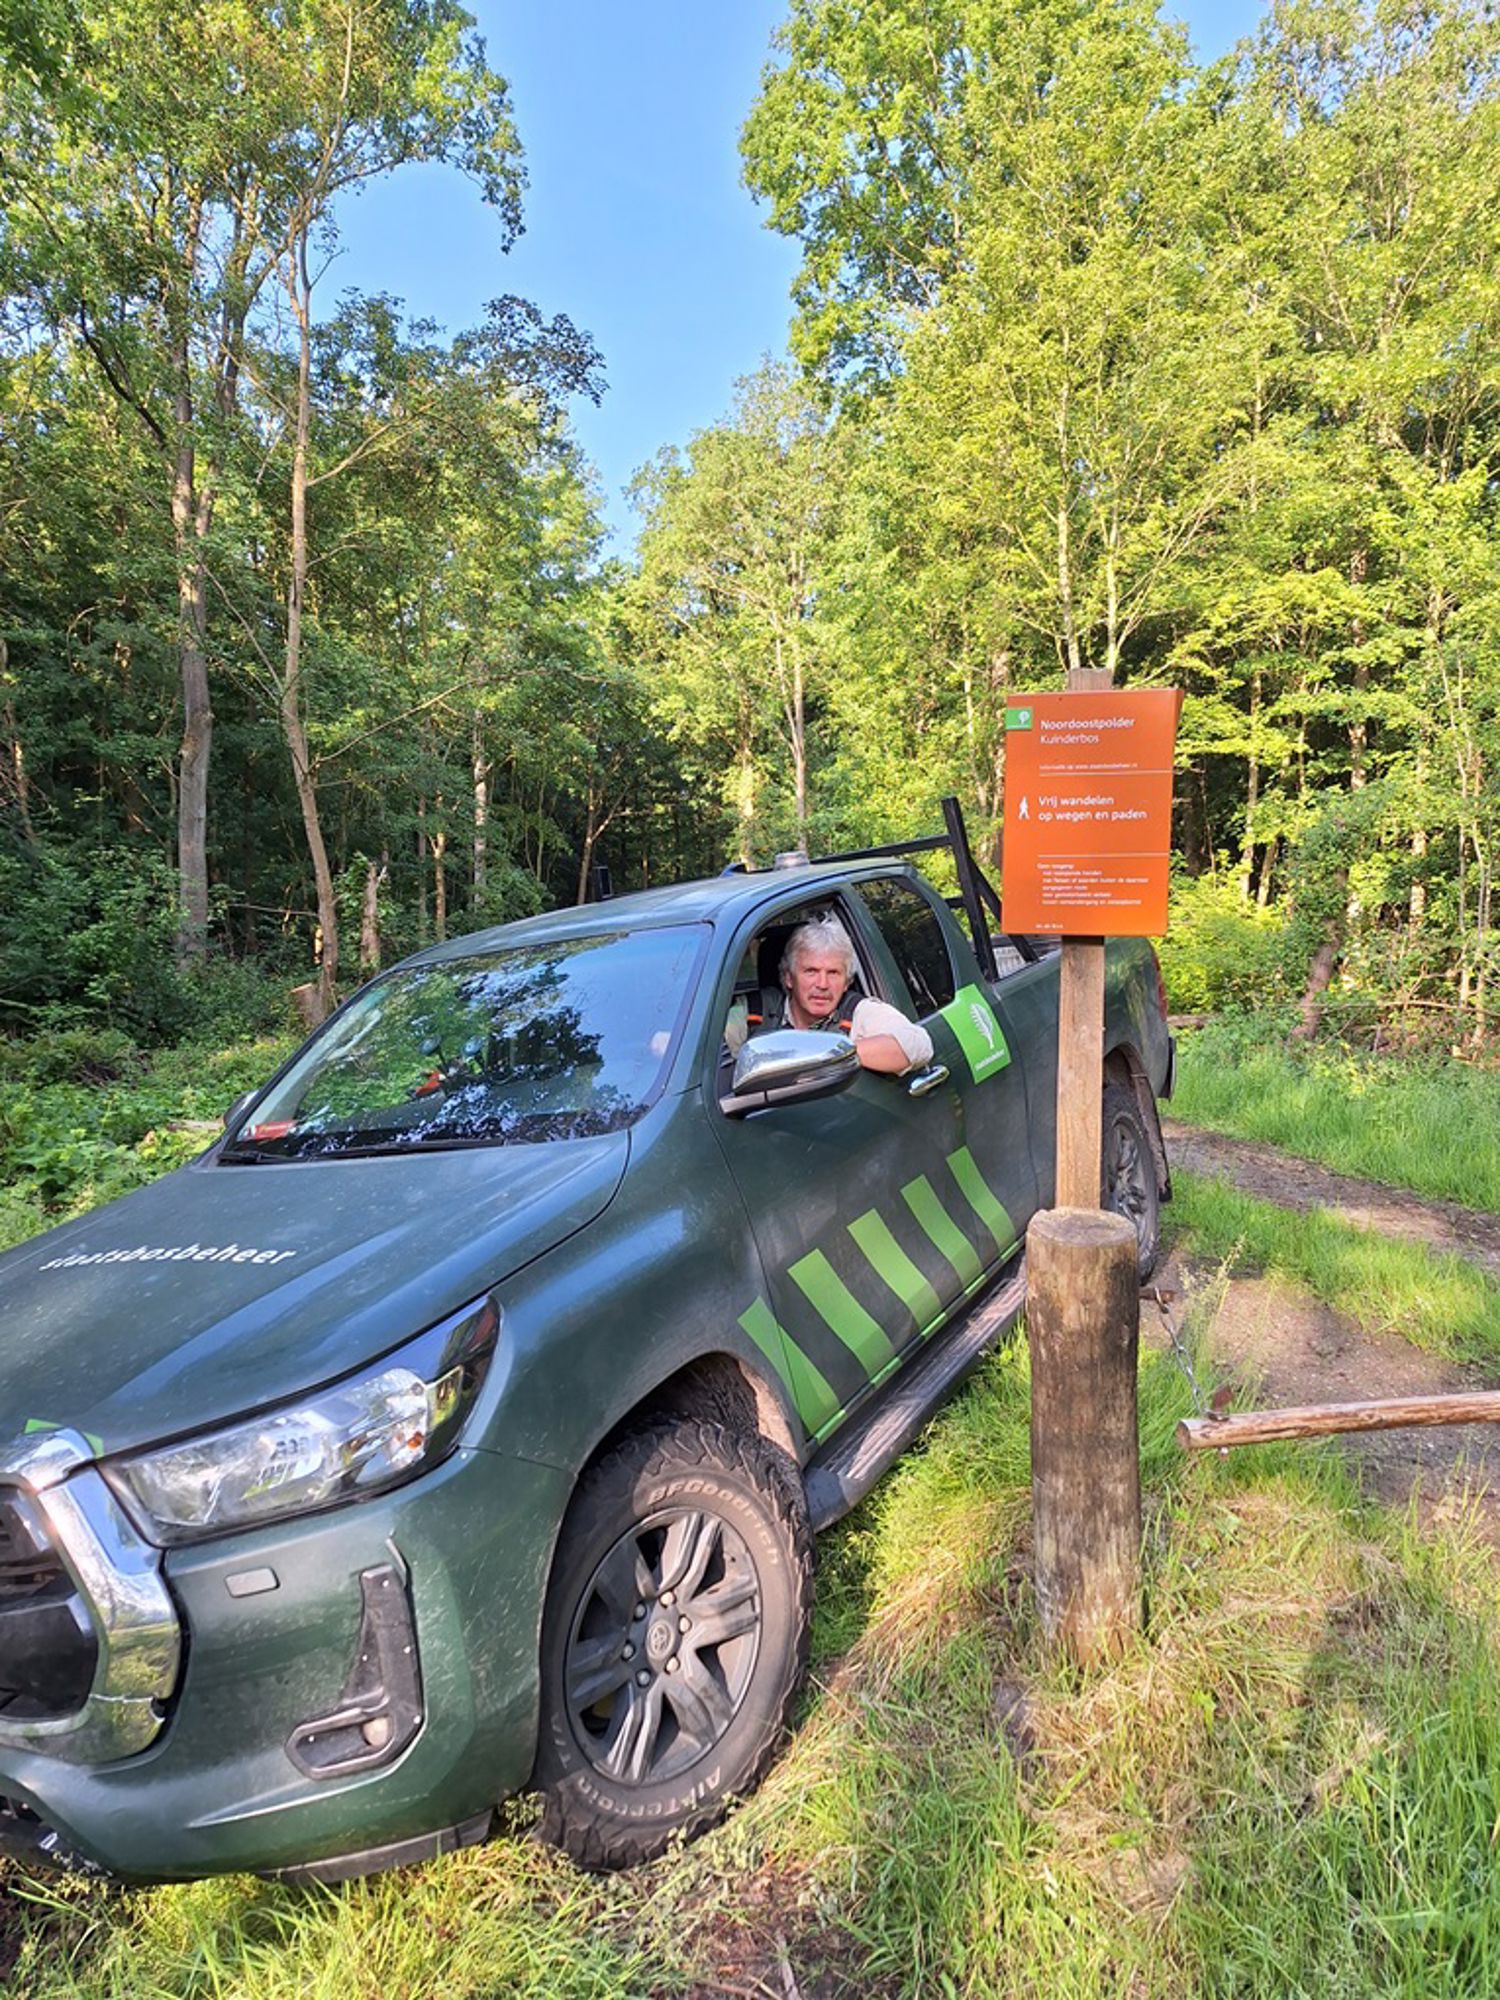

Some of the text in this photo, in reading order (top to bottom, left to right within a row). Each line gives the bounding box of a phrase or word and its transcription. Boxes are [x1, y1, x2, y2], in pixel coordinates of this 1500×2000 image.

[1040, 717, 1135, 731] Noordoostpolder
[1040, 734, 1100, 744] Kuinderbos
[1038, 795, 1114, 808] Vrij wandelen
[1038, 808, 1147, 822] op wegen en paden
[39, 1243, 297, 1271] staatsbosbeheer
[647, 1479, 778, 1565] BFGoodrich
